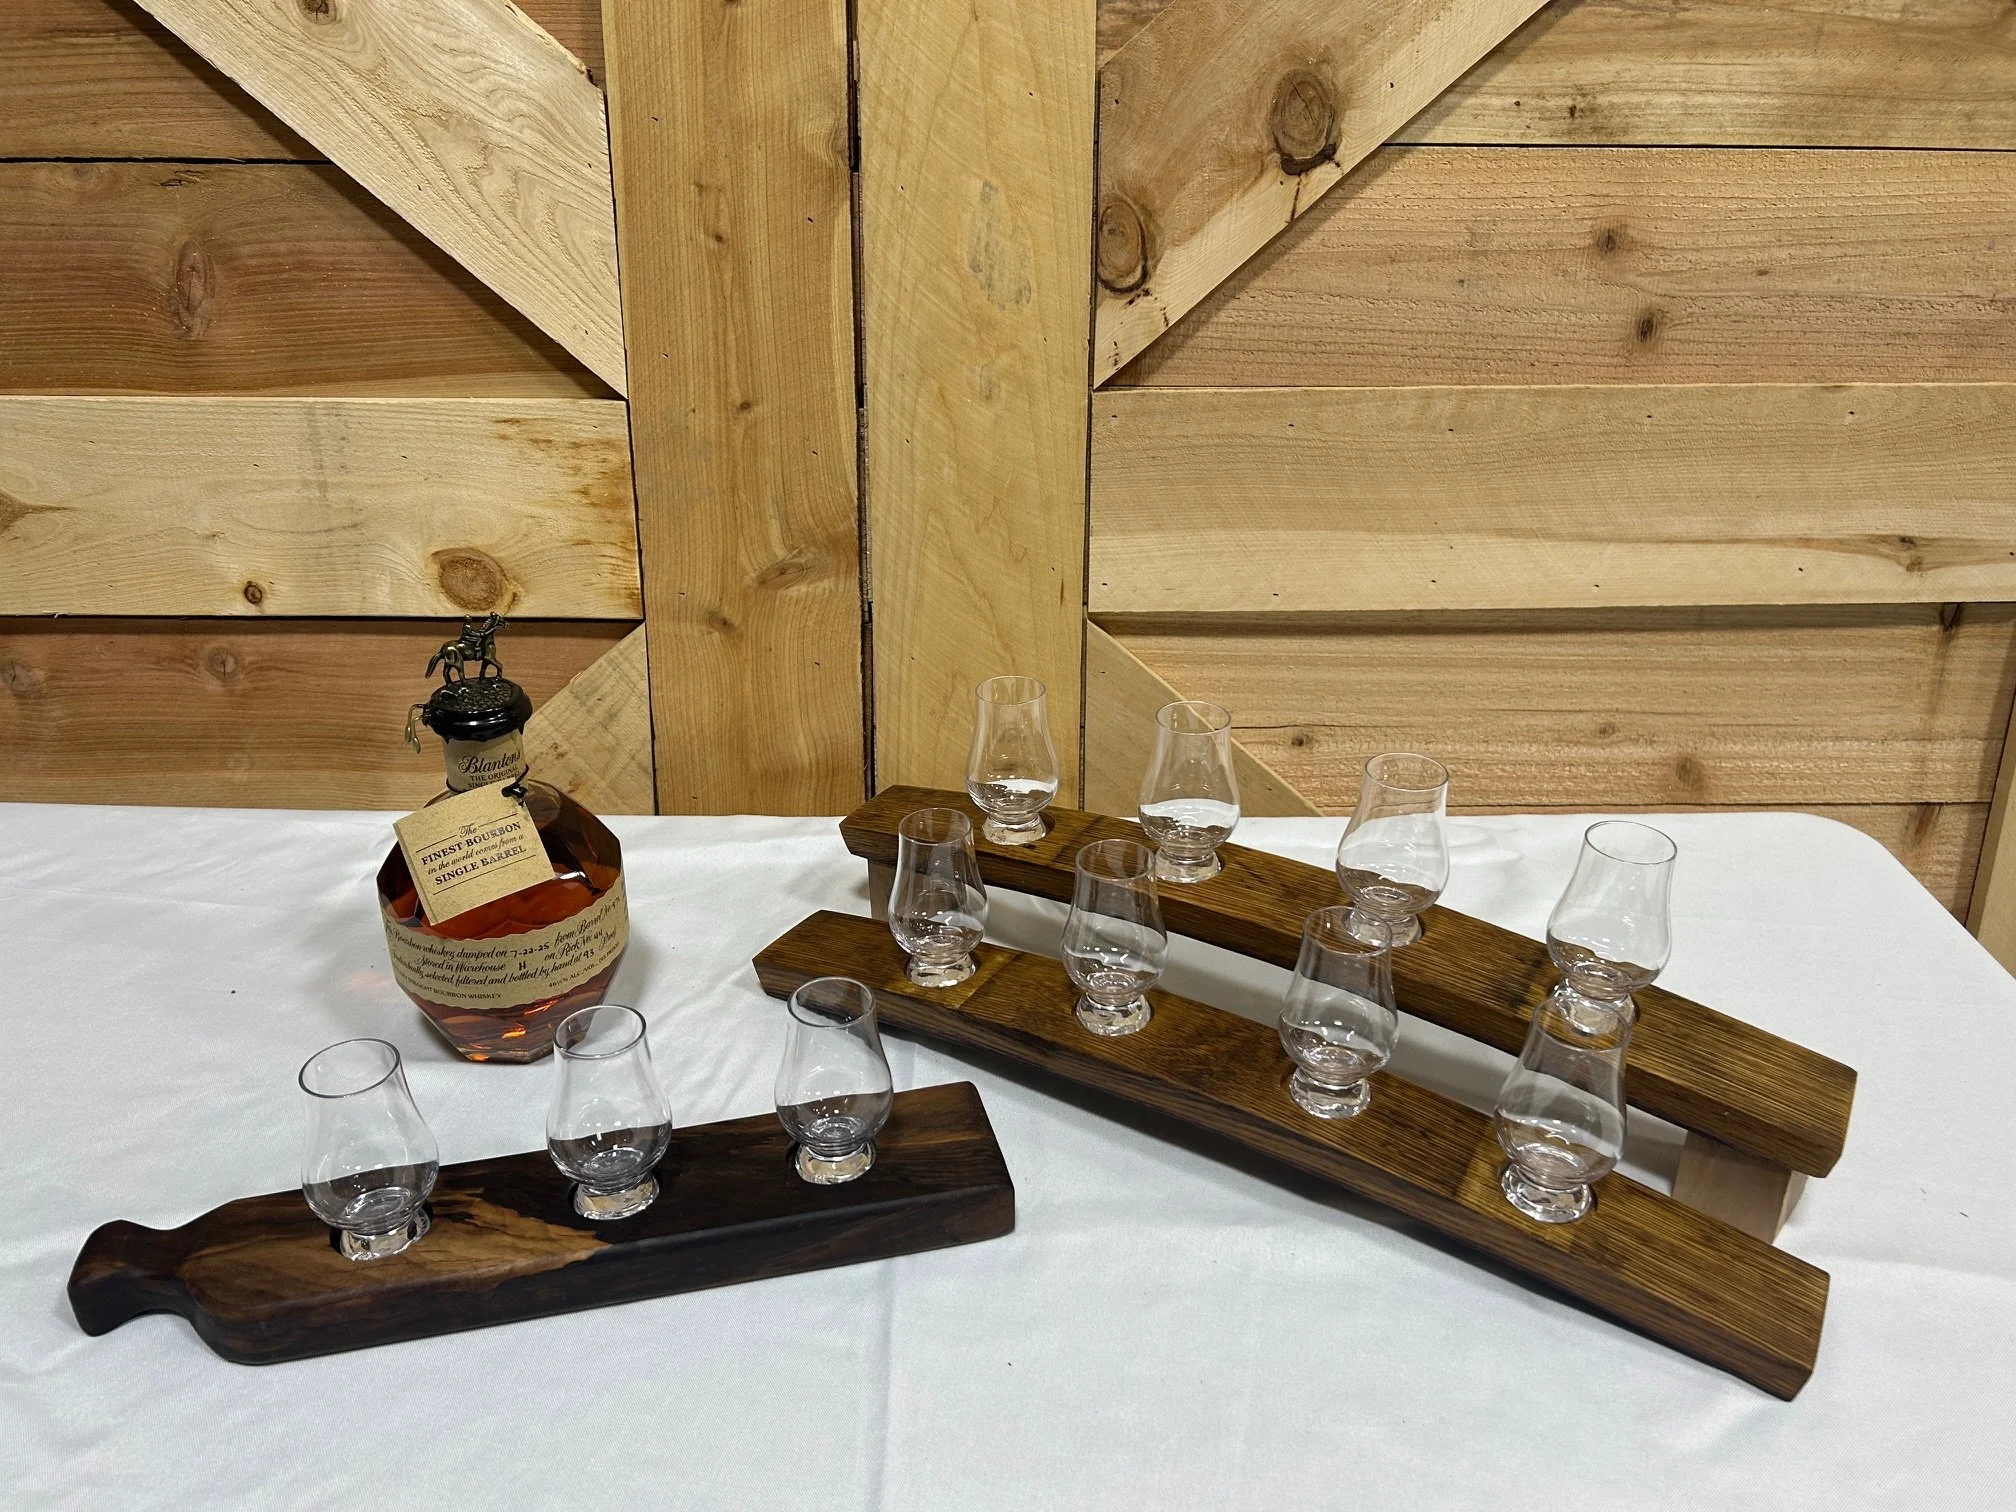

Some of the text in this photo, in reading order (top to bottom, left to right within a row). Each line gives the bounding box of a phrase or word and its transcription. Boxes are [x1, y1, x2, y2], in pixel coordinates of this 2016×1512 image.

[458, 747, 521, 773] Blanton's
[488, 765, 518, 780] ORIGINAL
[421, 821, 521, 865] FINEST BOURBON
[458, 822, 478, 838] The
[428, 866, 437, 875] in
[438, 859, 450, 871] the
[451, 849, 474, 866] world
[475, 842, 498, 856] comes
[498, 836, 517, 852] from
[435, 845, 527, 885] SINGLE BARREL
[422, 943, 455, 960] whiskey
[456, 947, 496, 960] dumped
[496, 949, 508, 958] on
[510, 942, 549, 958] 7-22-25
[554, 931, 575, 948] from
[574, 908, 603, 937] Barrel
[413, 955, 445, 971] Stored
[445, 960, 454, 970] in
[455, 961, 507, 973] Warehouse
[518, 961, 527, 971] H
[544, 952, 555, 961] on
[555, 938, 580, 959] Rick
[455, 975, 488, 987] filtered
[488, 973, 509, 985] and
[510, 967, 540, 983] bottled
[539, 968, 550, 980] by
[550, 956, 576, 973] hand
[574, 952, 582, 963] at
[583, 949, 595, 959] 93
[433, 988, 467, 999] BOURBON
